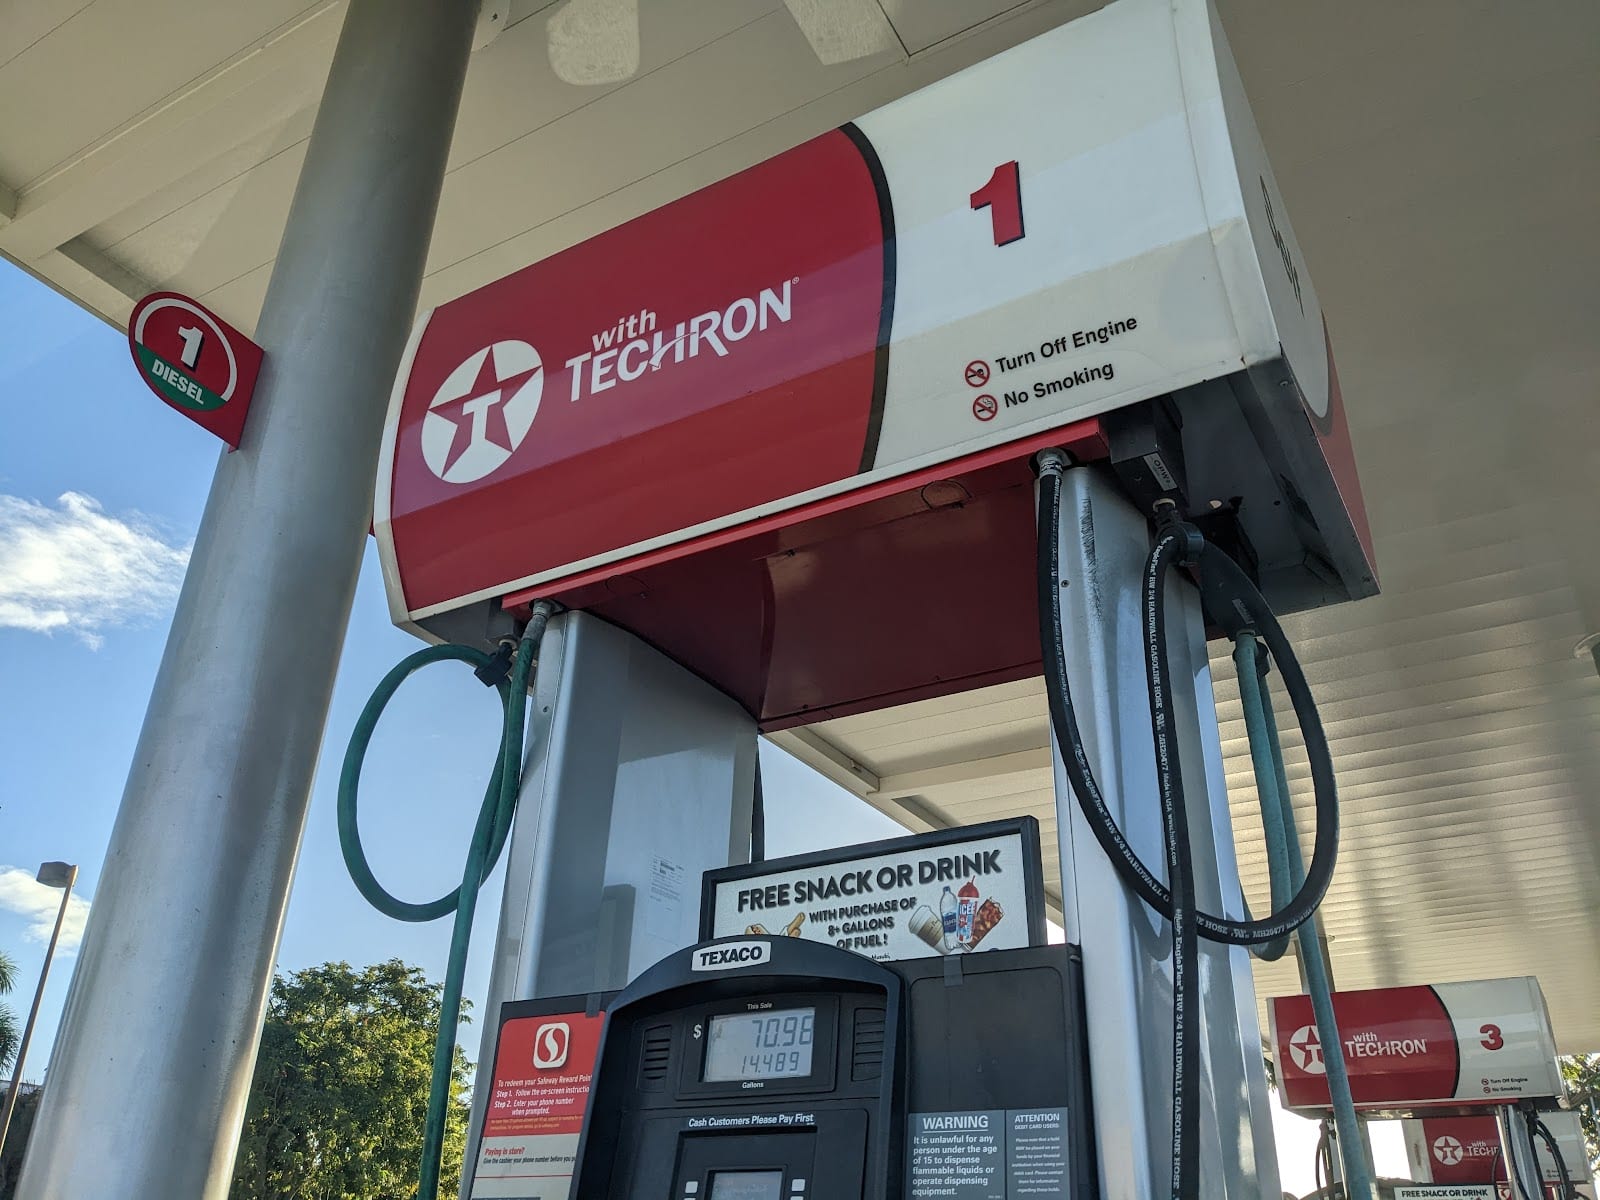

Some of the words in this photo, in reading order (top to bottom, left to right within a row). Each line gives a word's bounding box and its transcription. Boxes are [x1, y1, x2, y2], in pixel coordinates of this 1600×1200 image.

[970, 160, 1025, 247] 1
[592, 308, 657, 353] with
[178, 326, 205, 372] 1
[564, 279, 794, 402] TECHRON
[995, 351, 1035, 374] Turn
[1040, 337, 1067, 359] Off
[1072, 317, 1138, 349] Engine
[152, 359, 205, 405] DIESEL
[1004, 390, 1029, 408] No
[1033, 362, 1115, 399] Smoking
[737, 882, 791, 914] FREE
[794, 868, 875, 905] SNACK
[876, 863, 913, 889] OR
[918, 849, 1002, 885] DRINK
[809, 908, 838, 923] WITH
[839, 899, 899, 920] PURCHASE
[900, 896, 917, 911] OF
[827, 924, 841, 937] 8+
[842, 916, 895, 935] GALLONS
[836, 937, 852, 949] OF
[700, 945, 763, 967] TEXACO
[693, 1024, 702, 1040] $
[1353, 1032, 1378, 1042] with
[1480, 1024, 1504, 1051] 3
[1345, 1039, 1427, 1058] TECHRON
[1175, 1031, 1183, 1094] HARDWALL
[742, 1081, 764, 1089] Gallons
[688, 1117, 707, 1127] Cash
[708, 1116, 750, 1127] Customers
[751, 1115, 778, 1125] Please
[778, 1114, 794, 1125] Pay
[794, 1113, 815, 1123] First
[922, 1115, 988, 1130] WARNING
[1014, 1112, 1060, 1123] ATTENTION
[913, 1136, 919, 1144] It
[921, 1136, 928, 1144] is
[930, 1135, 964, 1144] unlawful
[965, 1134, 977, 1143] for
[978, 1135, 994, 1144] any
[913, 1147, 940, 1156] person
[942, 1145, 965, 1154] under
[967, 1144, 981, 1153] the
[982, 1146, 998, 1155] age
[912, 1156, 921, 1164] of
[923, 1156, 933, 1164] 15
[934, 1156, 943, 1164] to
[944, 1155, 980, 1166] dispense
[912, 1166, 954, 1175] flammable
[956, 1165, 983, 1175] liquids
[912, 1177, 943, 1187] operate
[944, 1176, 988, 1187] dispensing
[912, 1186, 957, 1197] equipment.
[1401, 1190, 1420, 1198] FREE
[1421, 1189, 1448, 1197] SNACK
[1448, 1189, 1460, 1197] OR
[1462, 1188, 1489, 1197] DRINK
